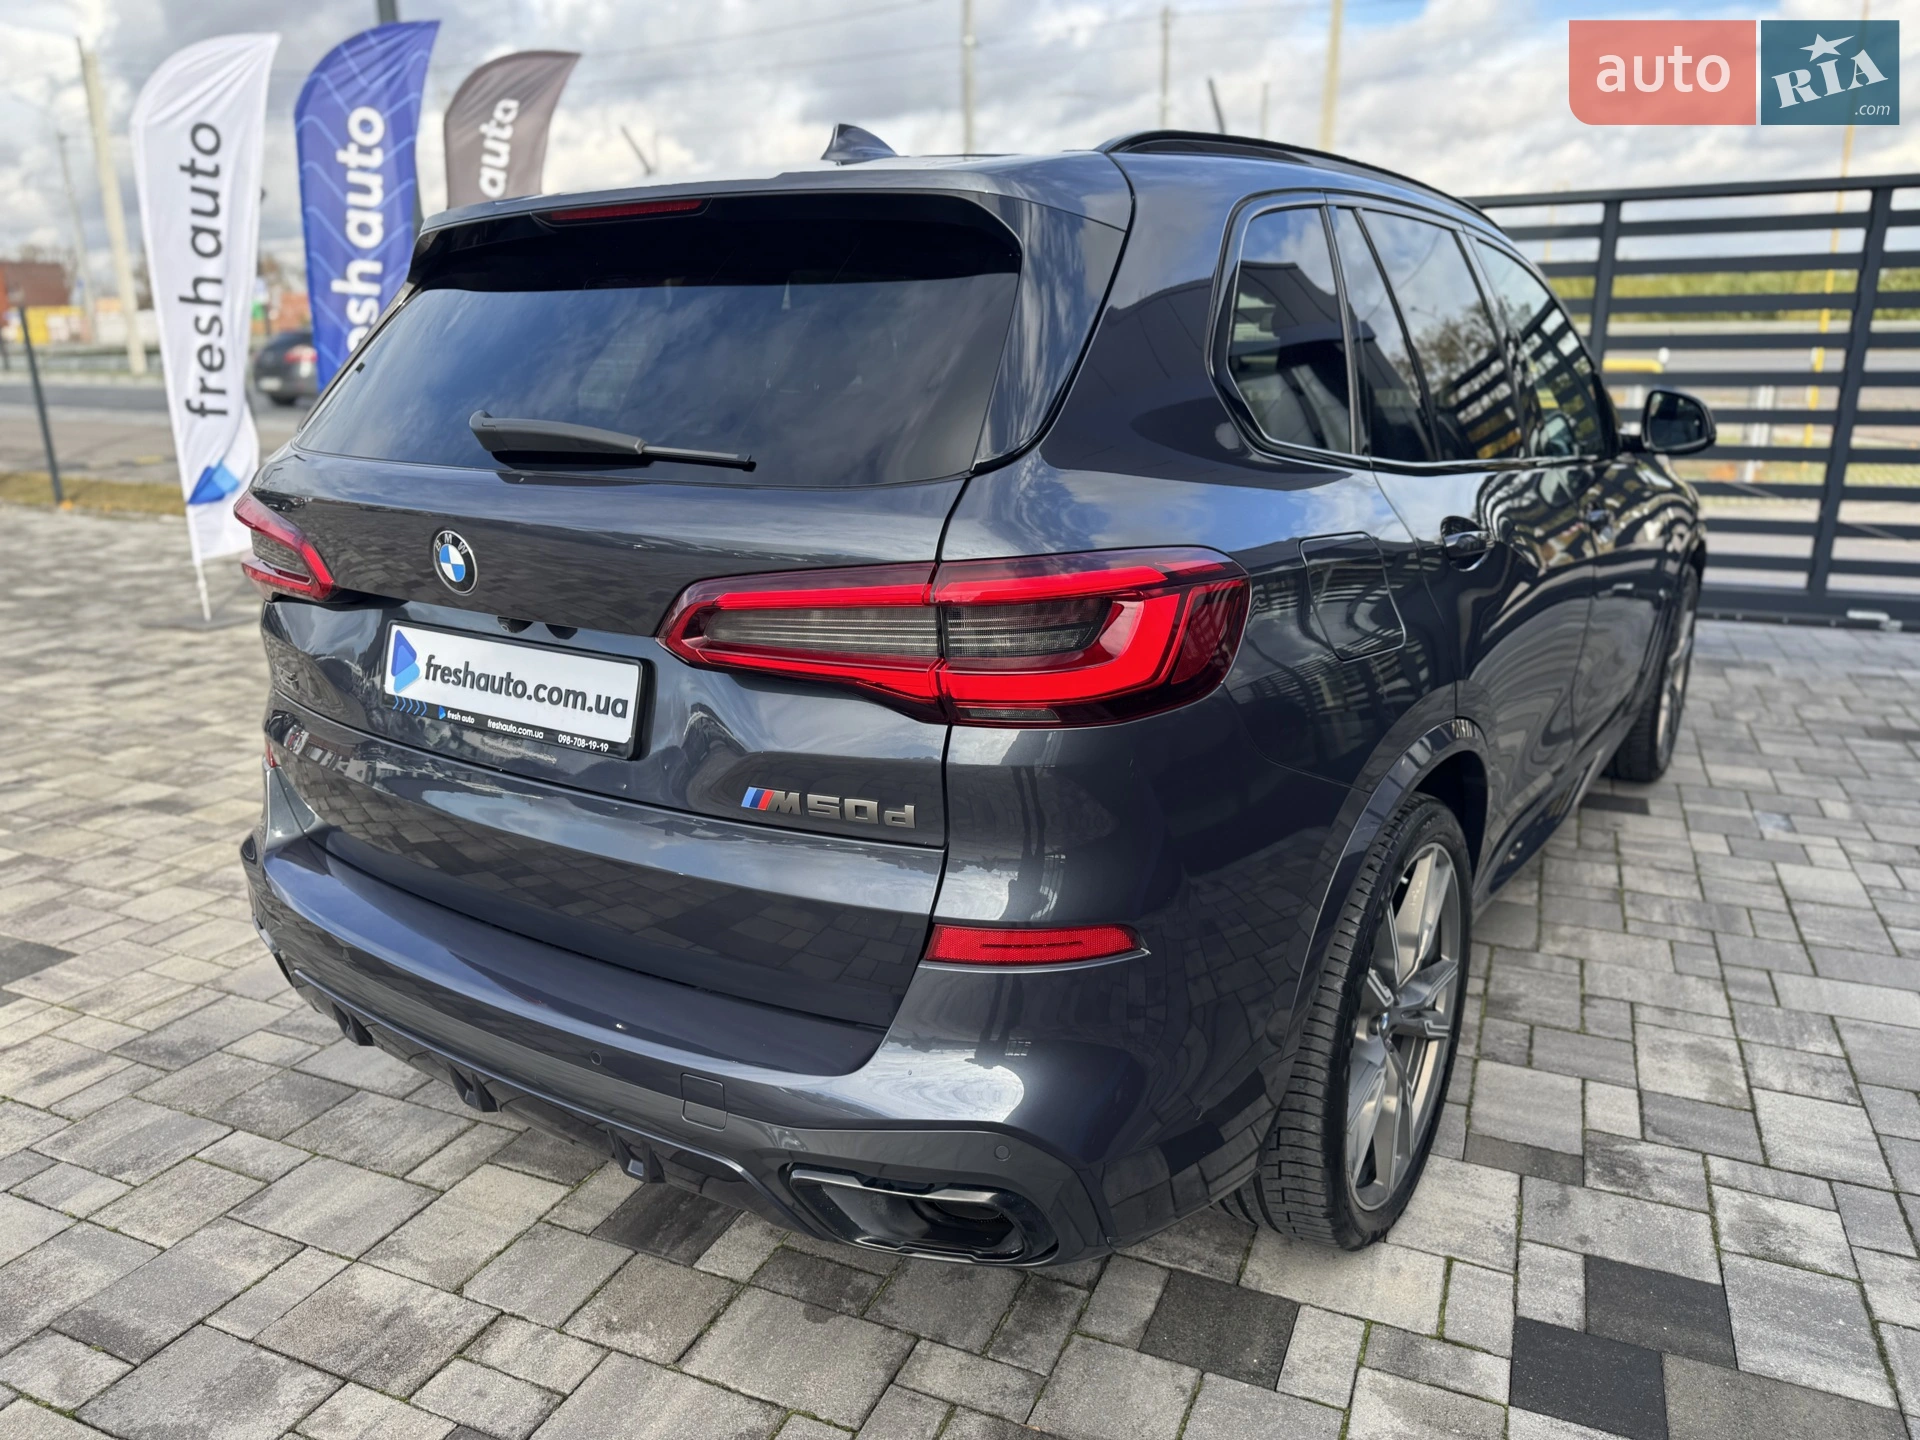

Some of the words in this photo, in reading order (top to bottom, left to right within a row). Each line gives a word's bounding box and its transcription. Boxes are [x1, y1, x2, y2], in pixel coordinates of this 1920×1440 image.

[179, 122, 221, 260] auto
[335, 106, 385, 250] auto
[178, 276, 229, 418] fresh
[435, 533, 469, 555] BMW
[425, 654, 629, 719] freshauto.com.ua
[447, 710, 461, 721] fresh
[461, 715, 475, 724] auto
[487, 719, 544, 739] freshauto.com.ua
[558, 734, 609, 752] 098-708-19-19
